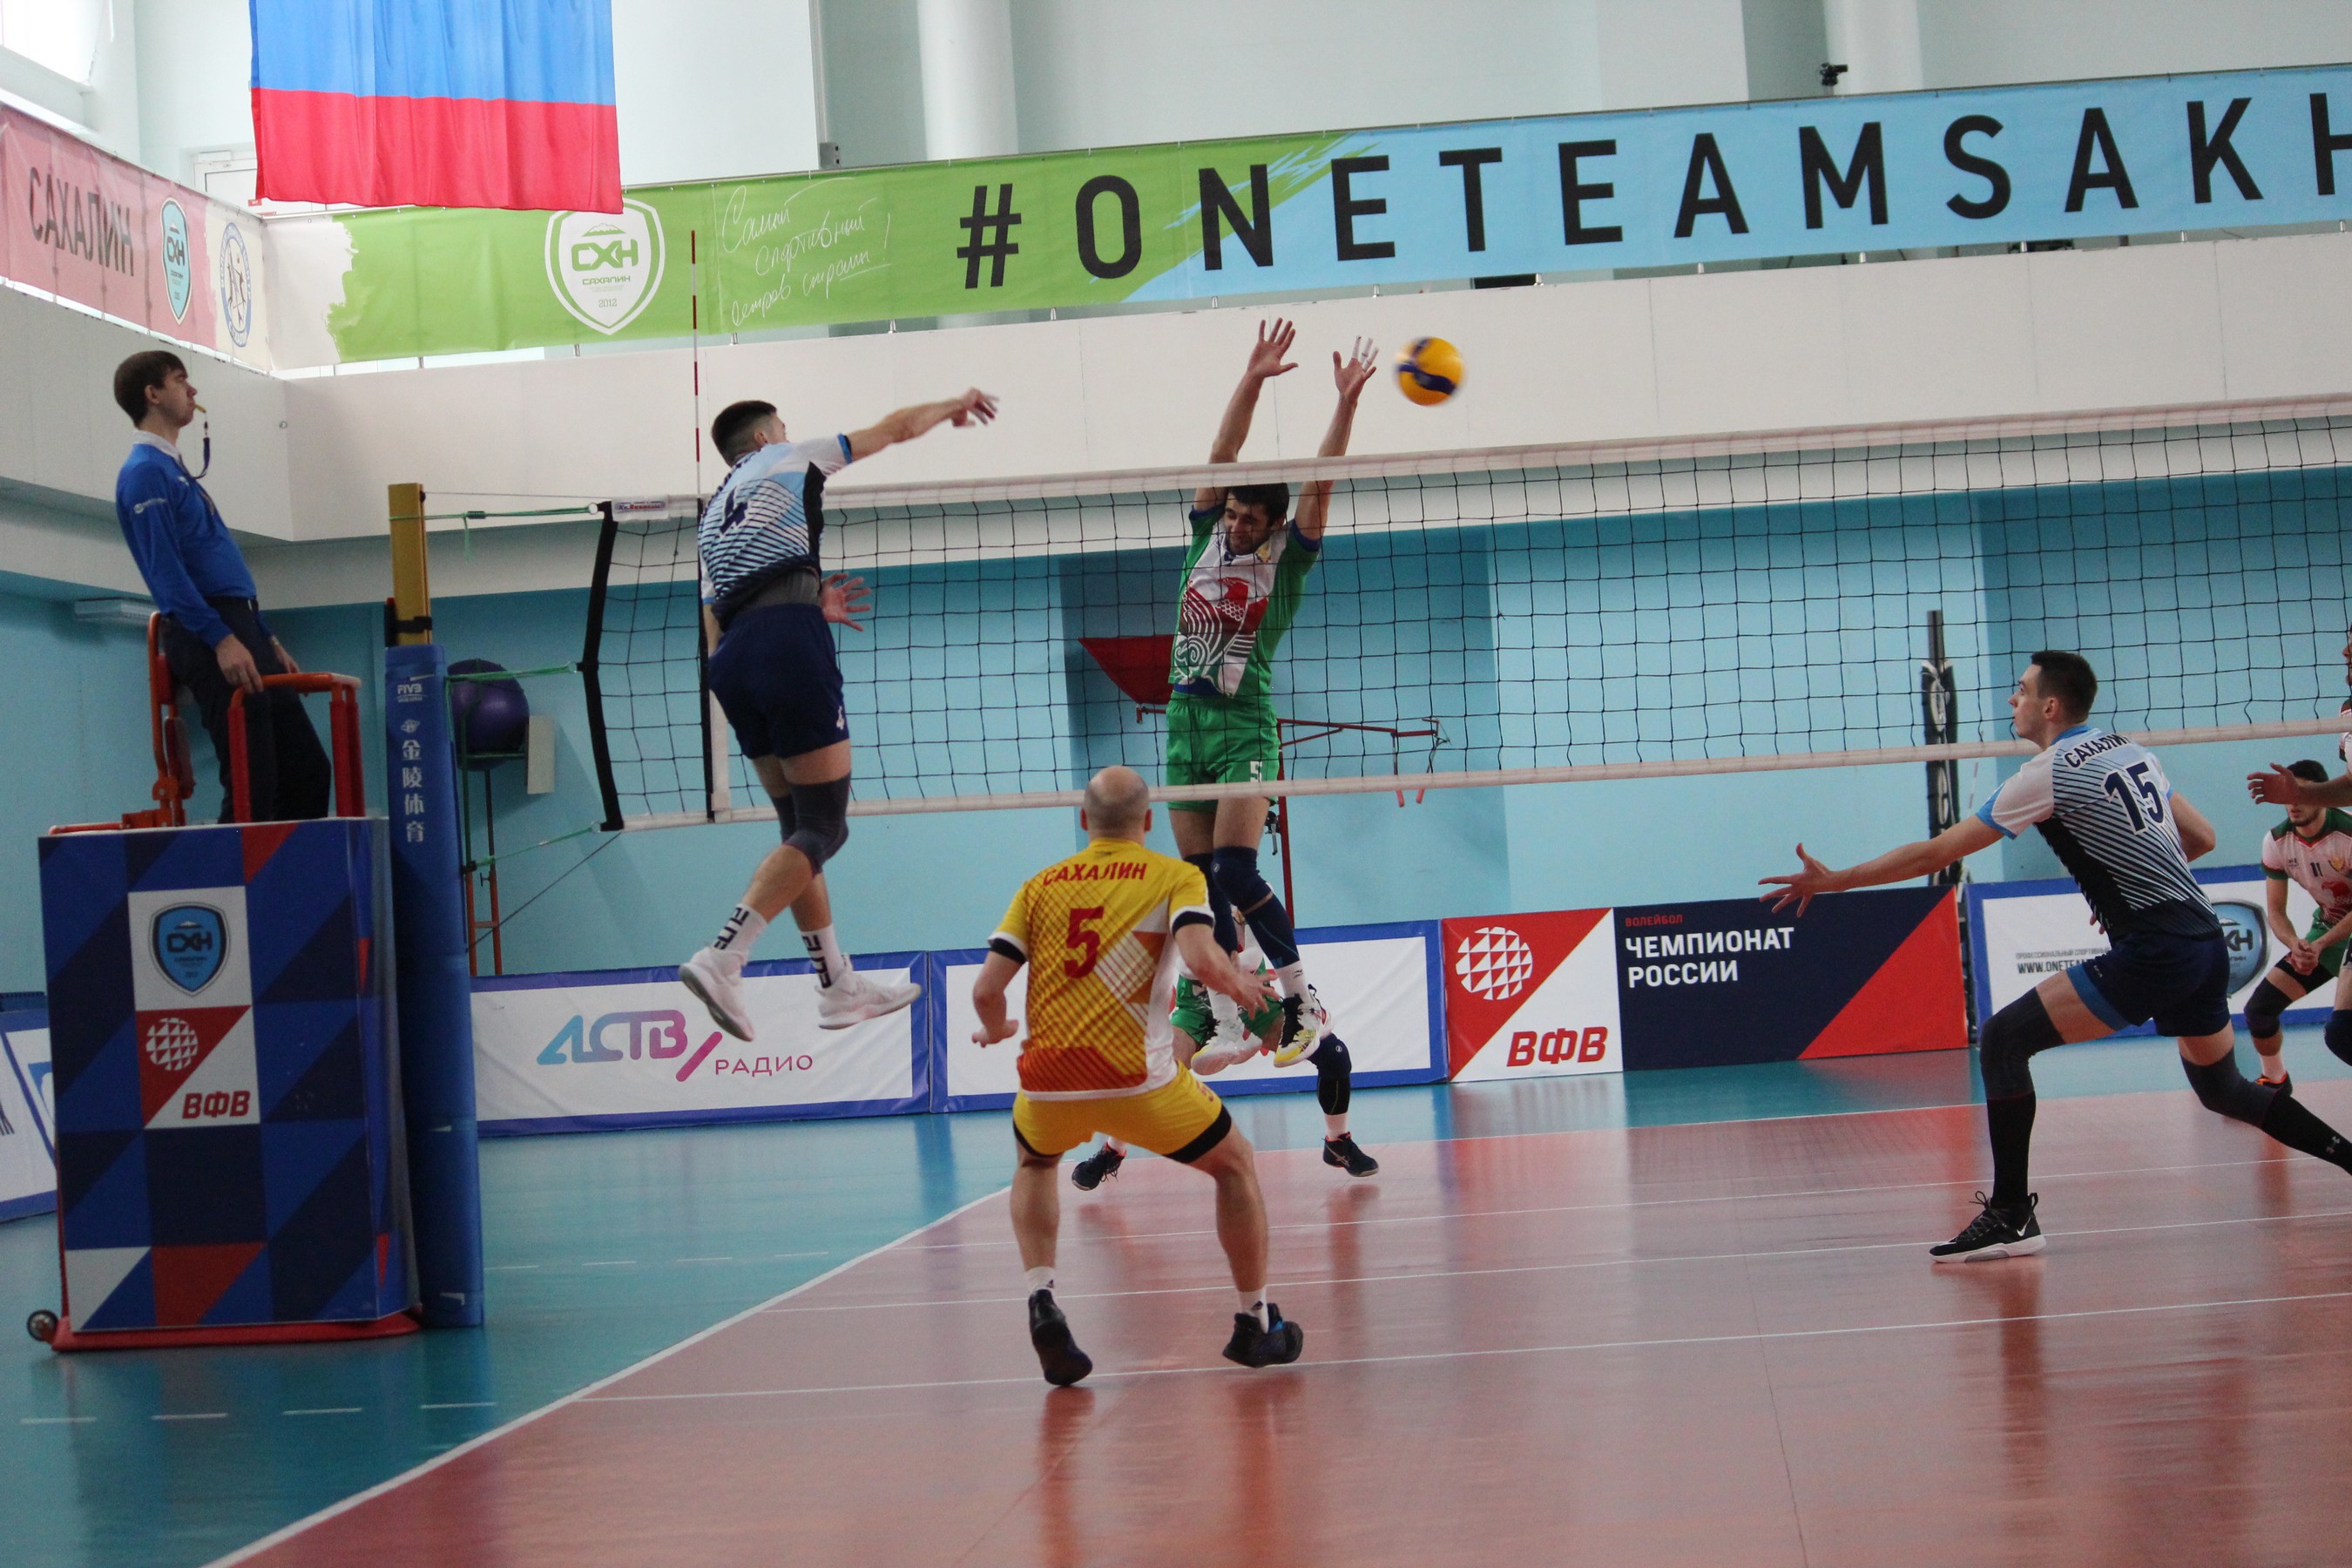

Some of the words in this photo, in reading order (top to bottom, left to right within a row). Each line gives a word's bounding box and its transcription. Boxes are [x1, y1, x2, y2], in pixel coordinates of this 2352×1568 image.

[29, 166, 135, 277] САХАЛИН
[582, 275, 631, 286] САХАЛИН
[598, 298, 618, 308] 2012
[402, 740, 425, 842] 金陵体育
[2105, 761, 2164, 832] 15
[1043, 862, 1147, 886] САХАЛИН
[1625, 915, 1683, 928] ВОЛЕЙБОЛ
[1064, 906, 1104, 979] 5
[1625, 927, 1794, 959] ЧЕМПИОНАТ
[1628, 960, 1739, 989] РОССИИ
[1507, 1026, 1608, 1067] ВФВ
[714, 1054, 814, 1077] РАДИО
[182, 1091, 251, 1119] ВФВ
